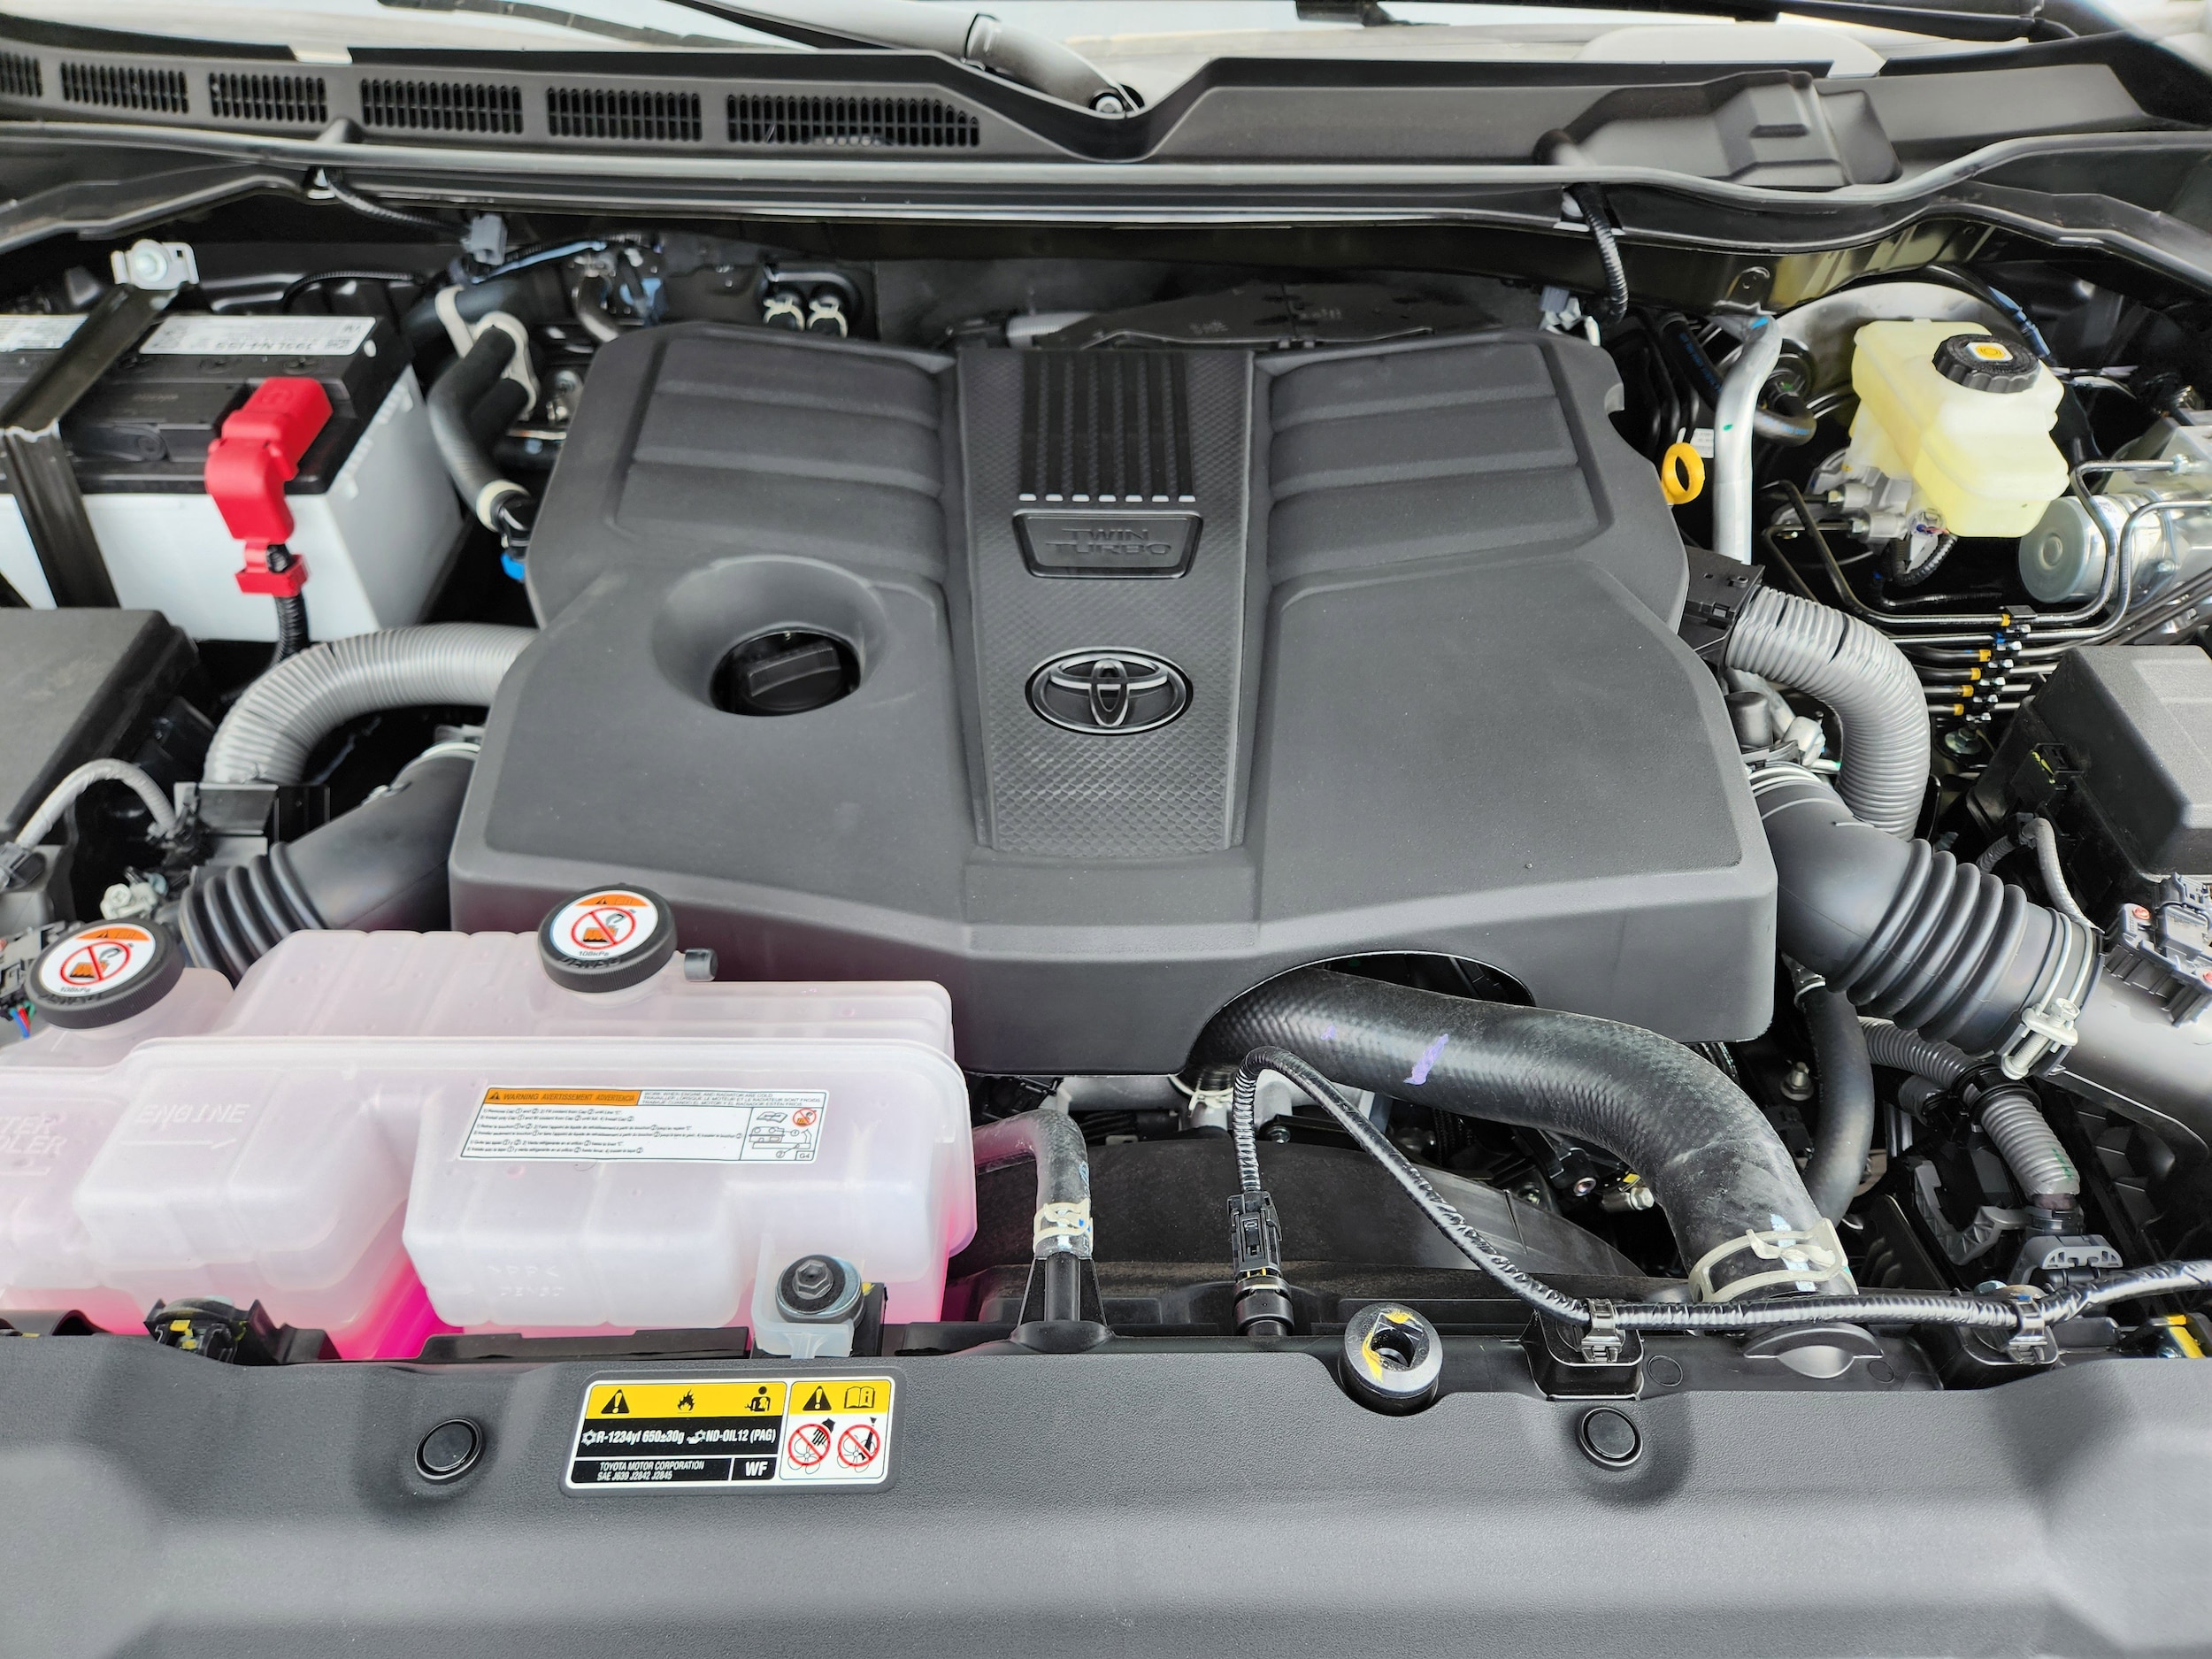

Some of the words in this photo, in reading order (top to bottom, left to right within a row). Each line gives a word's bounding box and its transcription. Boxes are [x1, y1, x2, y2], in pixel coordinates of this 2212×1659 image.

[1062, 528, 1148, 541] TWIN
[1045, 541, 1171, 554] TURBO
[134, 1103, 250, 1124] ENGINE
[595, 1430, 642, 1445] R-1234yf
[642, 1430, 685, 1445] 650±30g
[706, 1430, 749, 1443] ND-OIL12
[749, 1429, 776, 1444] (PAG)
[600, 1462, 626, 1471] TOYOTA
[627, 1461, 654, 1471] MOTOR
[655, 1461, 704, 1470] CORPORATION
[745, 1462, 768, 1477] WF
[597, 1472, 611, 1481] SAE
[611, 1471, 629, 1481] J639
[630, 1471, 651, 1481] J2842
[651, 1471, 672, 1480] J2845
